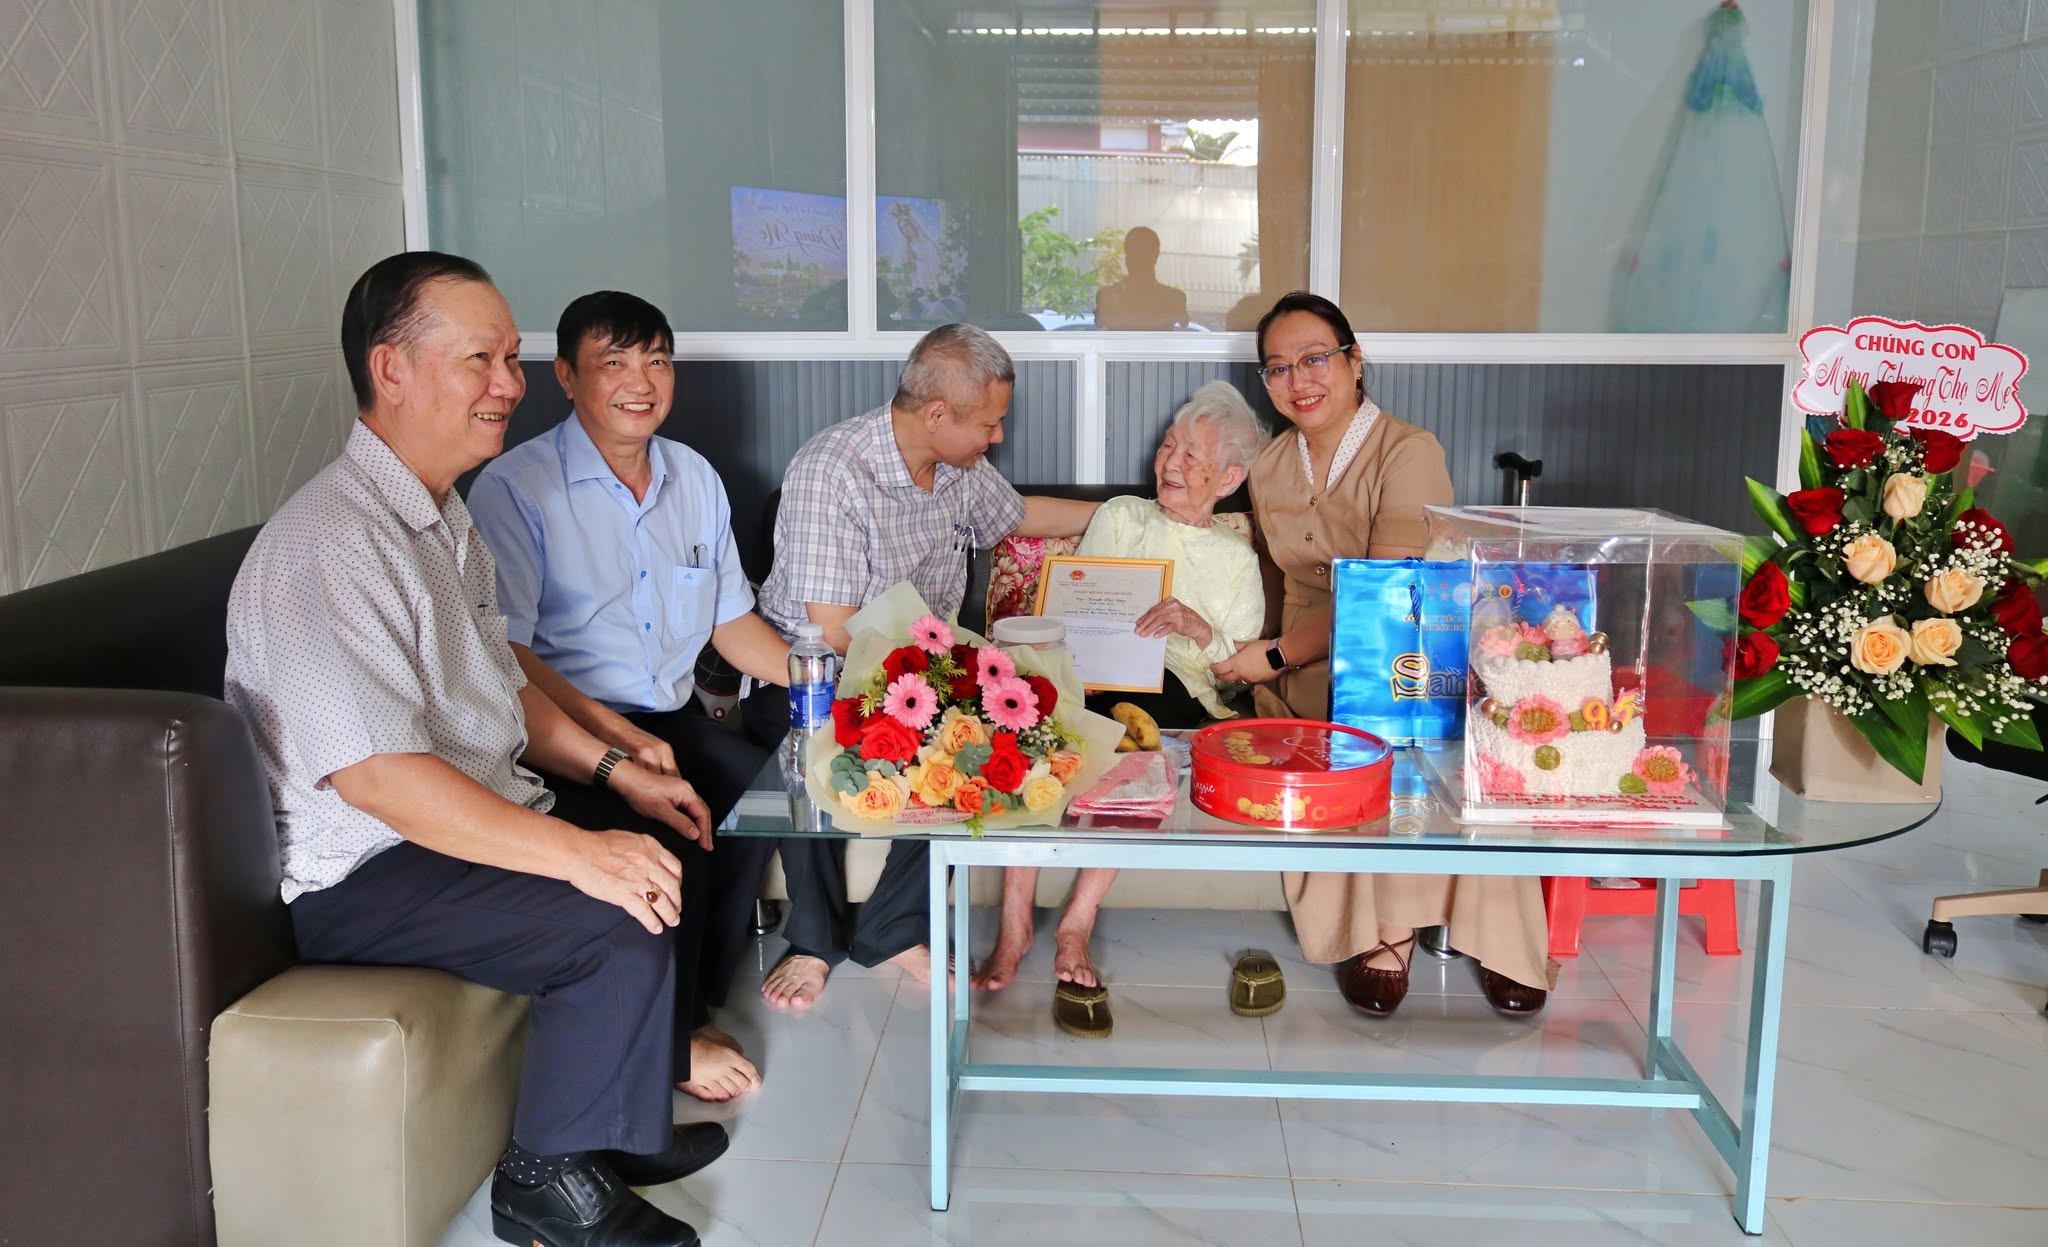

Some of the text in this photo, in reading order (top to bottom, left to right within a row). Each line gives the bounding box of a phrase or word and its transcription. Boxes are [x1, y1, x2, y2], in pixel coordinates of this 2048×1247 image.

[1855, 334, 1976, 361] CHÚNG CON
[1935, 365, 1968, 407] Thọ
[1976, 371, 2012, 412] Mẹ
[1906, 408, 1969, 428] 2026
